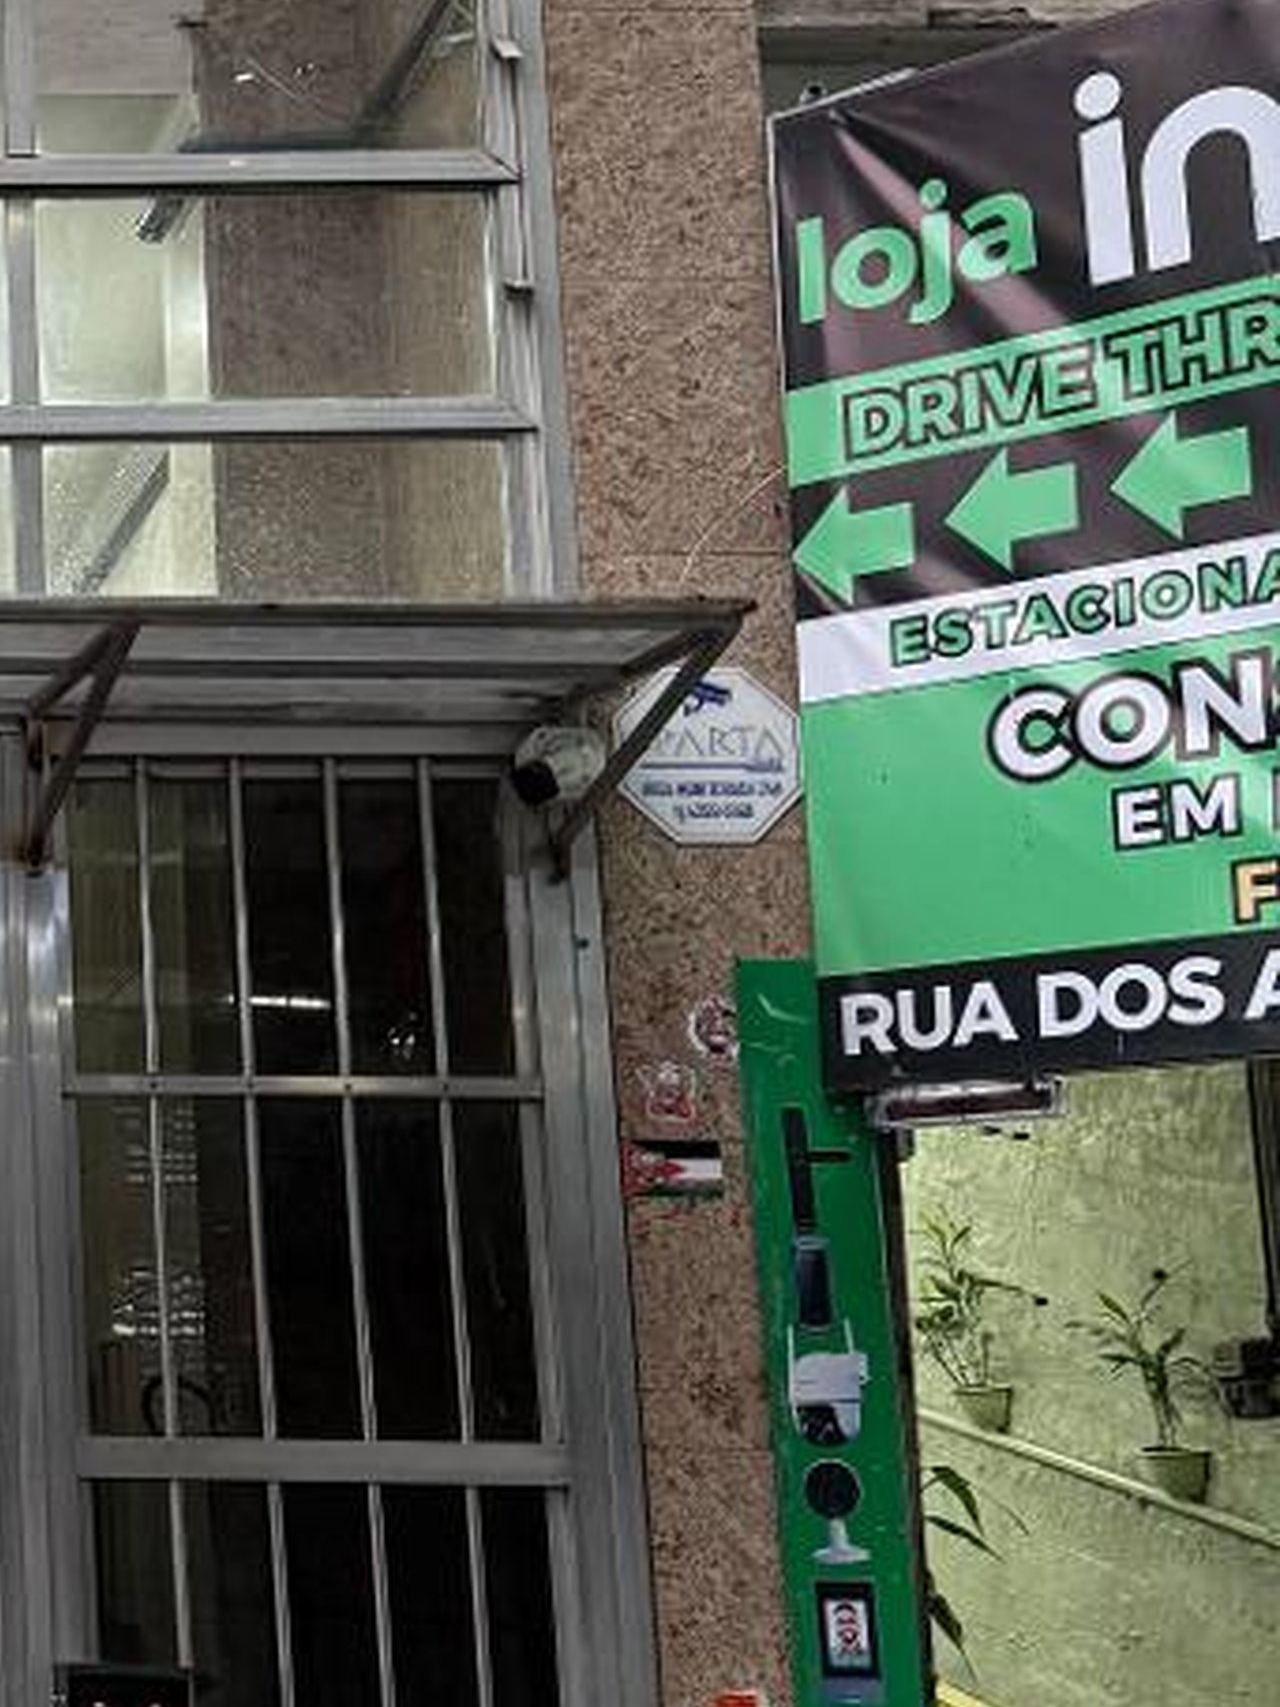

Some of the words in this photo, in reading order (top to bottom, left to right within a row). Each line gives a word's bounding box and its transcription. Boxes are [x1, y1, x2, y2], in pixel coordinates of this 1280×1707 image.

[796, 178, 1038, 324] loja
[844, 339, 1096, 462] DRIVE
[1111, 775, 1242, 851] EM
[840, 981, 1019, 1056] RUA
[1037, 955, 1225, 1040] DOS
